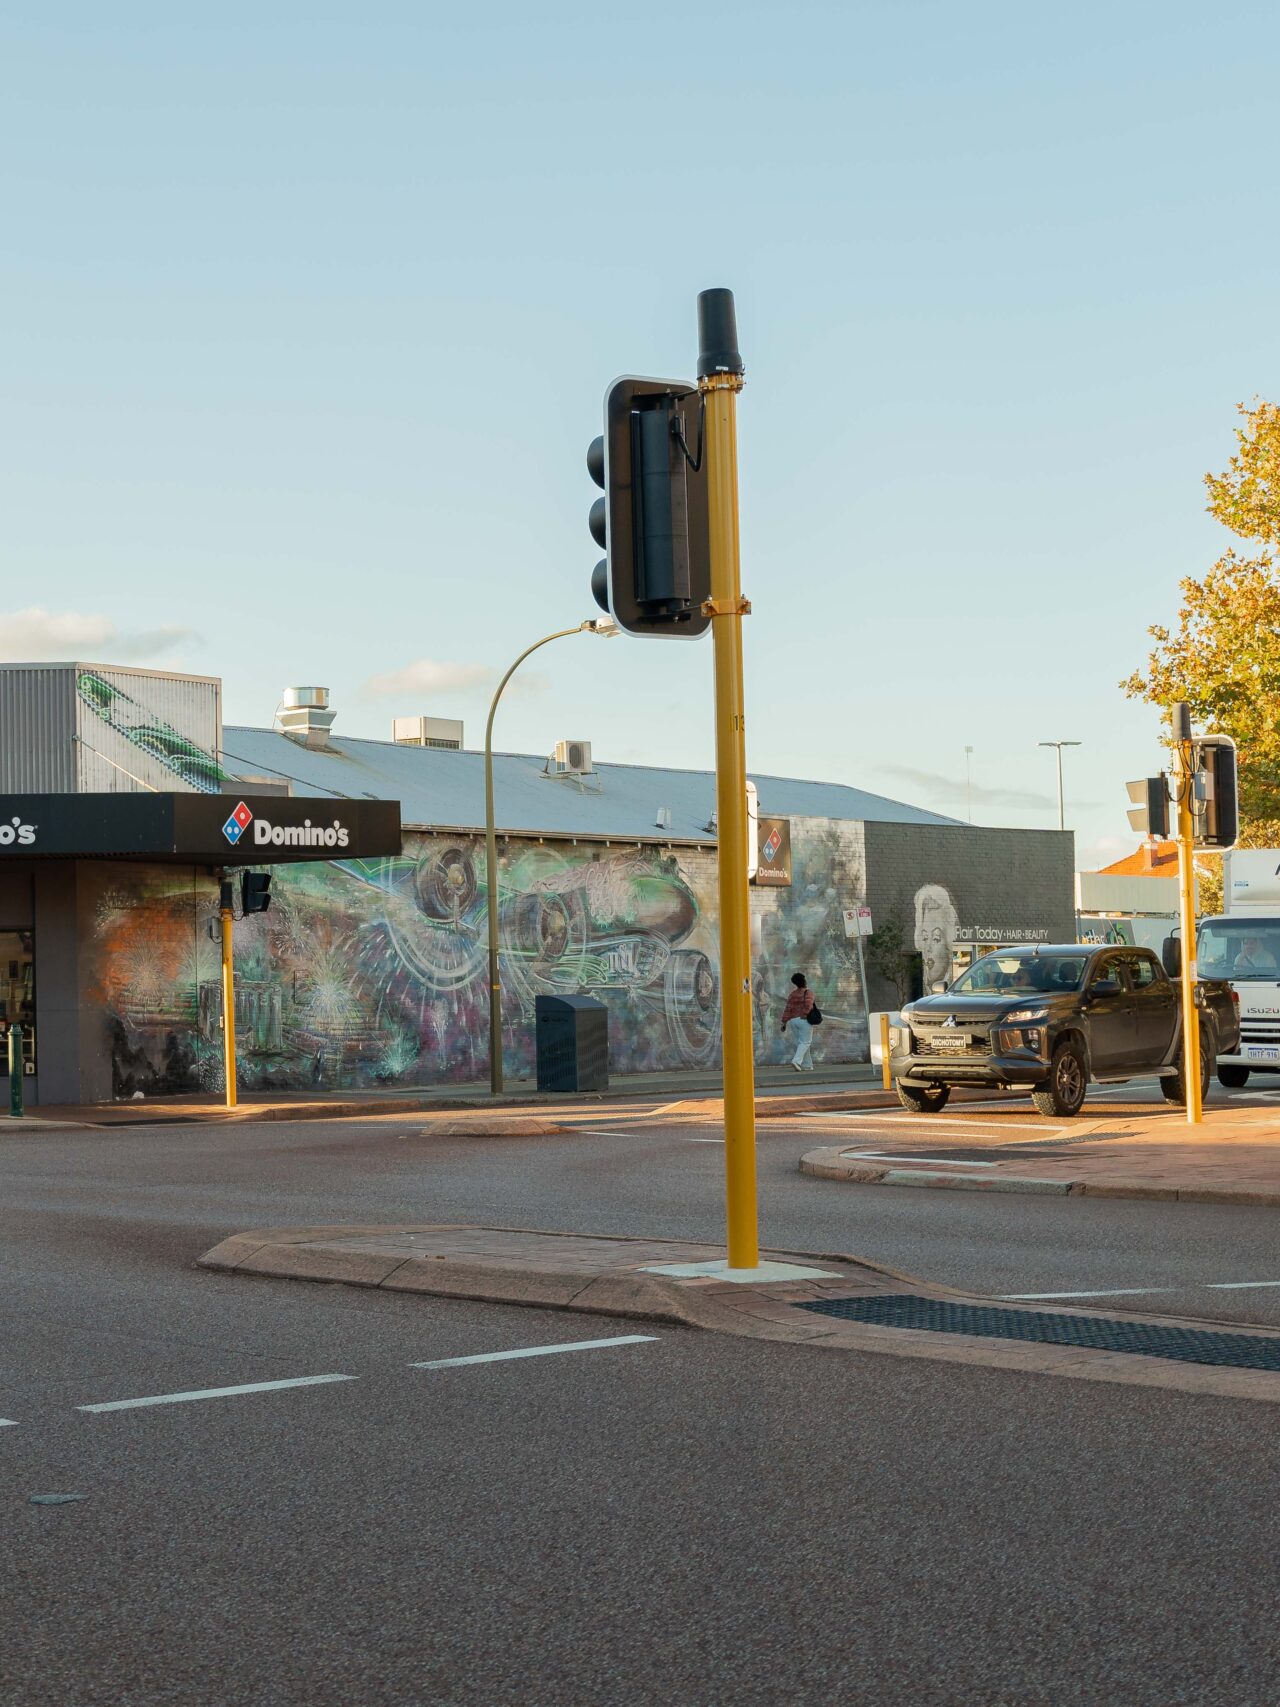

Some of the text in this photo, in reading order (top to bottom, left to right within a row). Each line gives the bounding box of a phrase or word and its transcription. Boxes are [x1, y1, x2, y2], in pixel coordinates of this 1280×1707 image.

[253, 818, 350, 847] Domino's
[758, 867, 788, 878] Domino's
[954, 925, 1049, 942] Flair Today HAIR BEAUTY
[932, 1039, 964, 1047] DICHOTOMY
